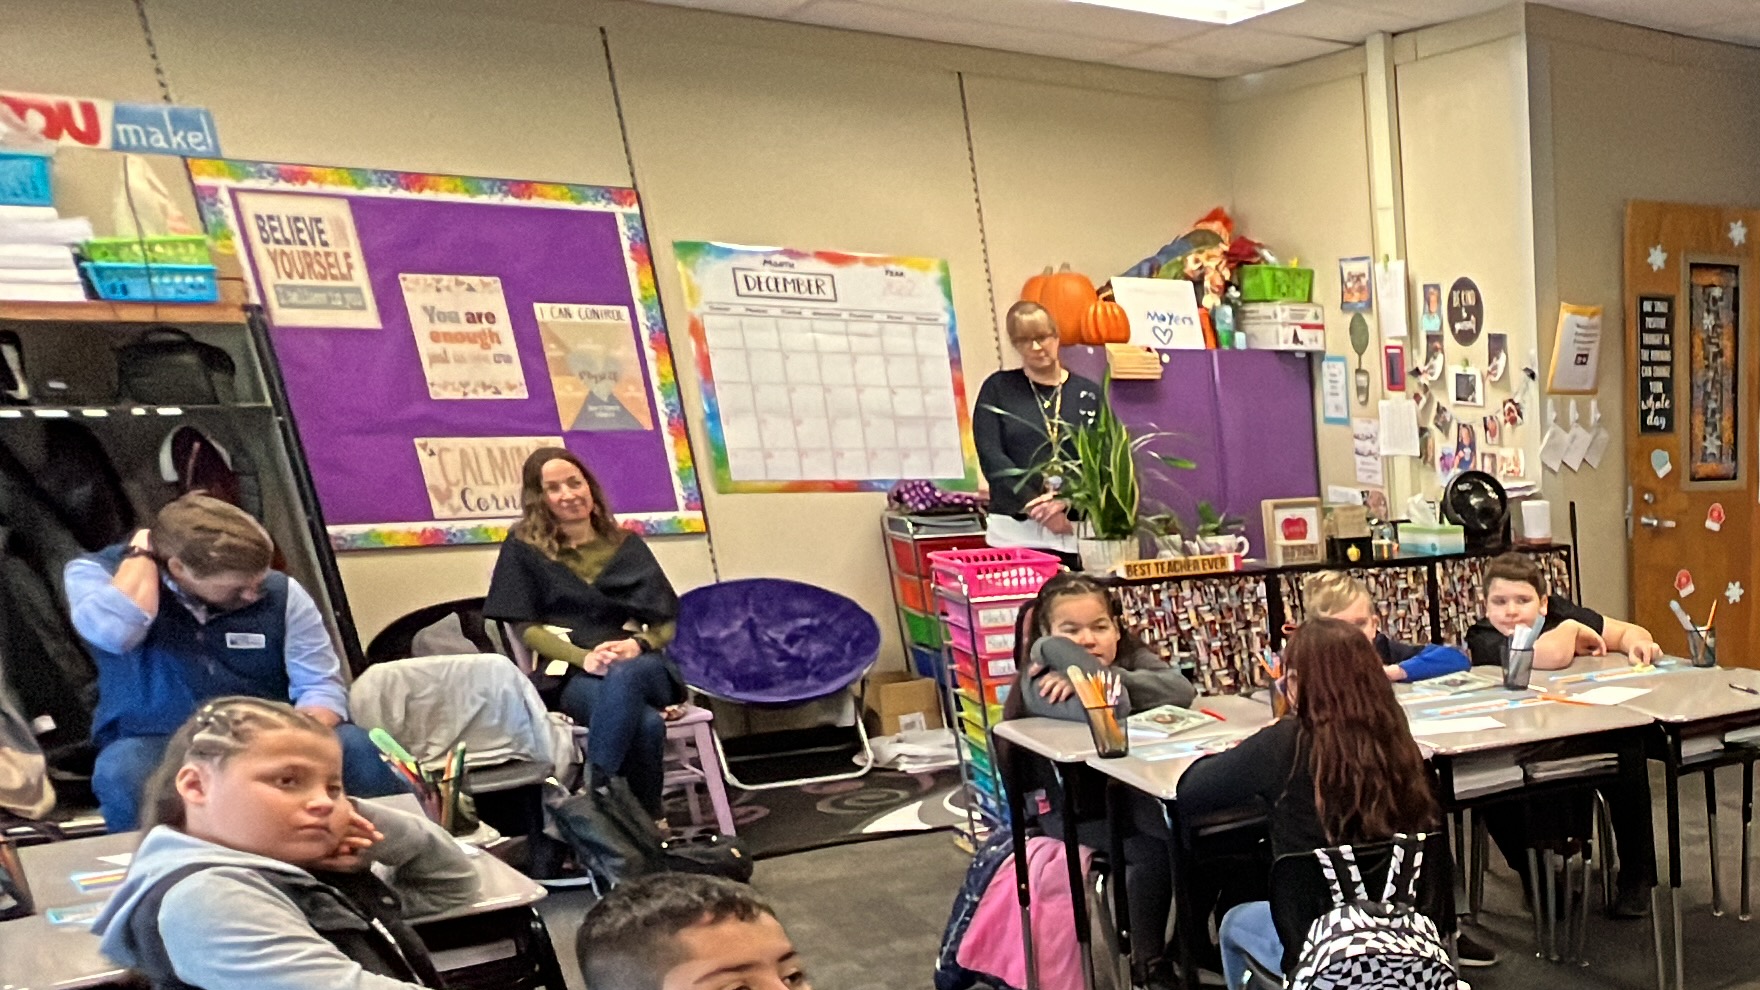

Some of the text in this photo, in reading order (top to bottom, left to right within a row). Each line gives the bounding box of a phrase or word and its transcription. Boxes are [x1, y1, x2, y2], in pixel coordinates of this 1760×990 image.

[254, 213, 330, 248] BELIEVE
[266, 247, 355, 281] YOURSELF
[743, 273, 827, 295] DECEMBER
[421, 305, 496, 324] You are
[550, 306, 573, 319] CAN
[578, 307, 626, 321] CONTROL
[429, 327, 502, 350] enough
[1646, 409, 1666, 430] day
[460, 487, 523, 512] Corn
[1126, 556, 1229, 577] BEST TEACHER EVER
